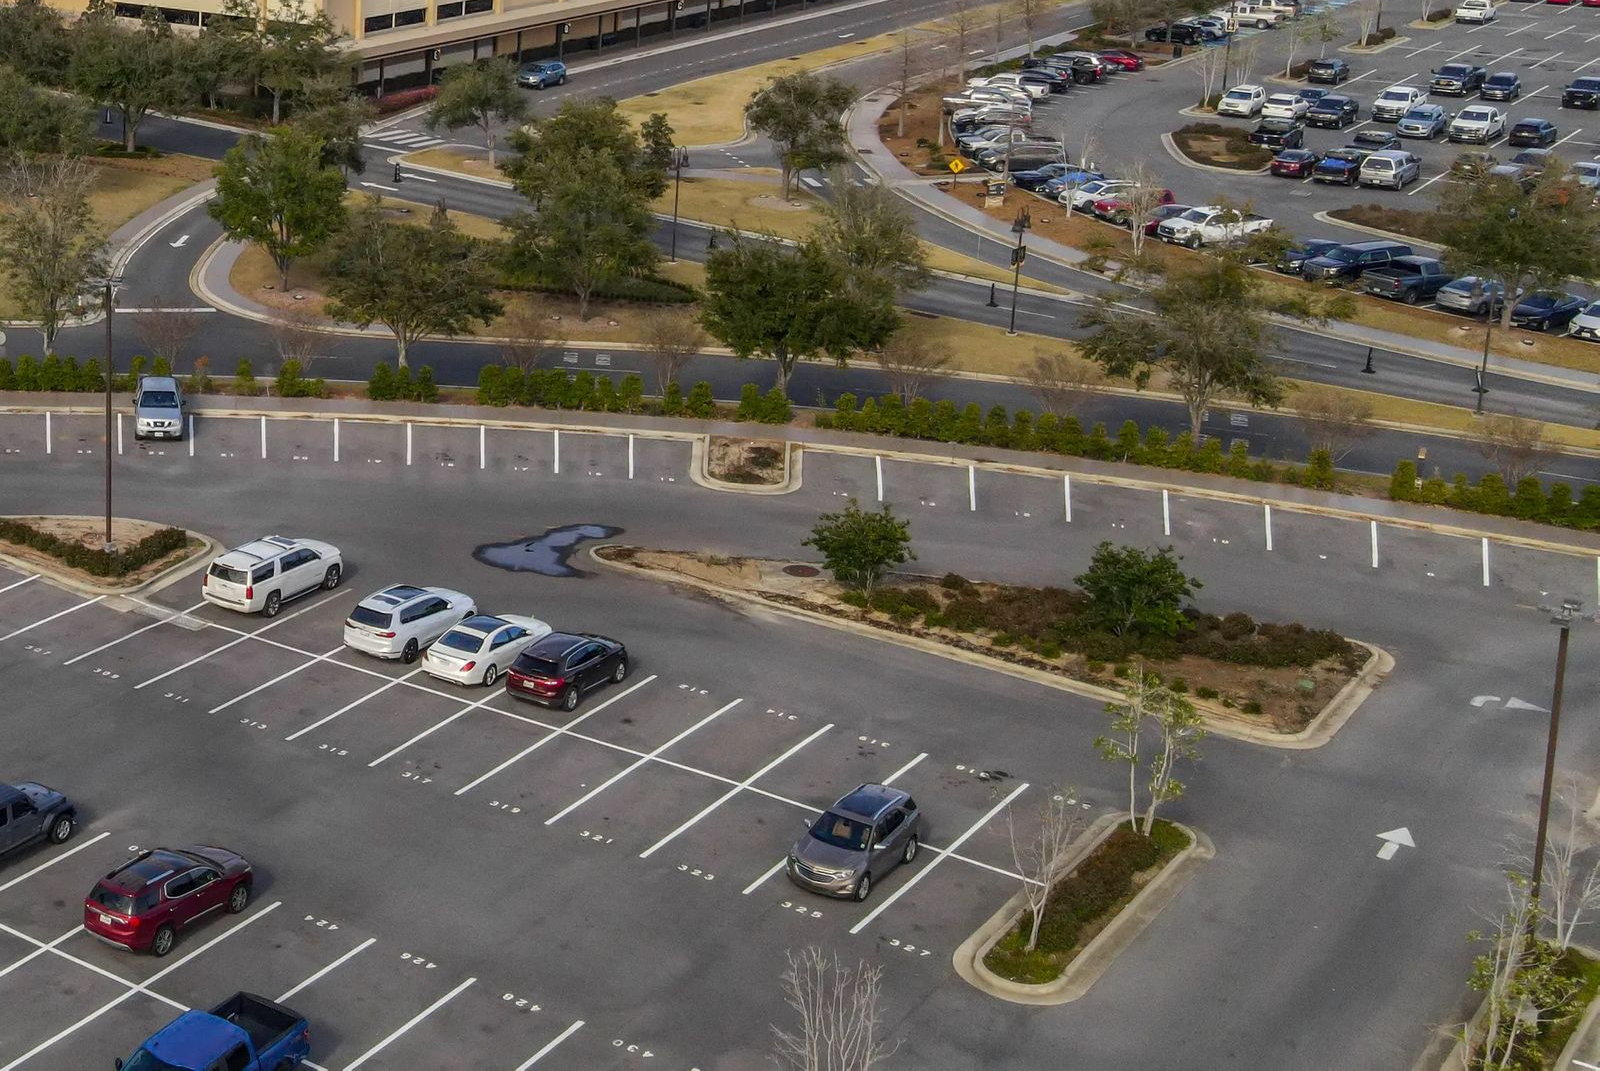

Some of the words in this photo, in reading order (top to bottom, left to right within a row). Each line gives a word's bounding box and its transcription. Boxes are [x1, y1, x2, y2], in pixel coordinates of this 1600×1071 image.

[163, 692, 190, 703] 311
[239, 718, 268, 730] 313
[401, 771, 433, 784] 317
[579, 830, 614, 844] 321
[677, 864, 715, 881] 323
[780, 901, 823, 918] 325
[304, 914, 339, 930] 424
[889, 938, 931, 956] 327
[399, 952, 437, 969] 426
[612, 1039, 654, 1058] 430
